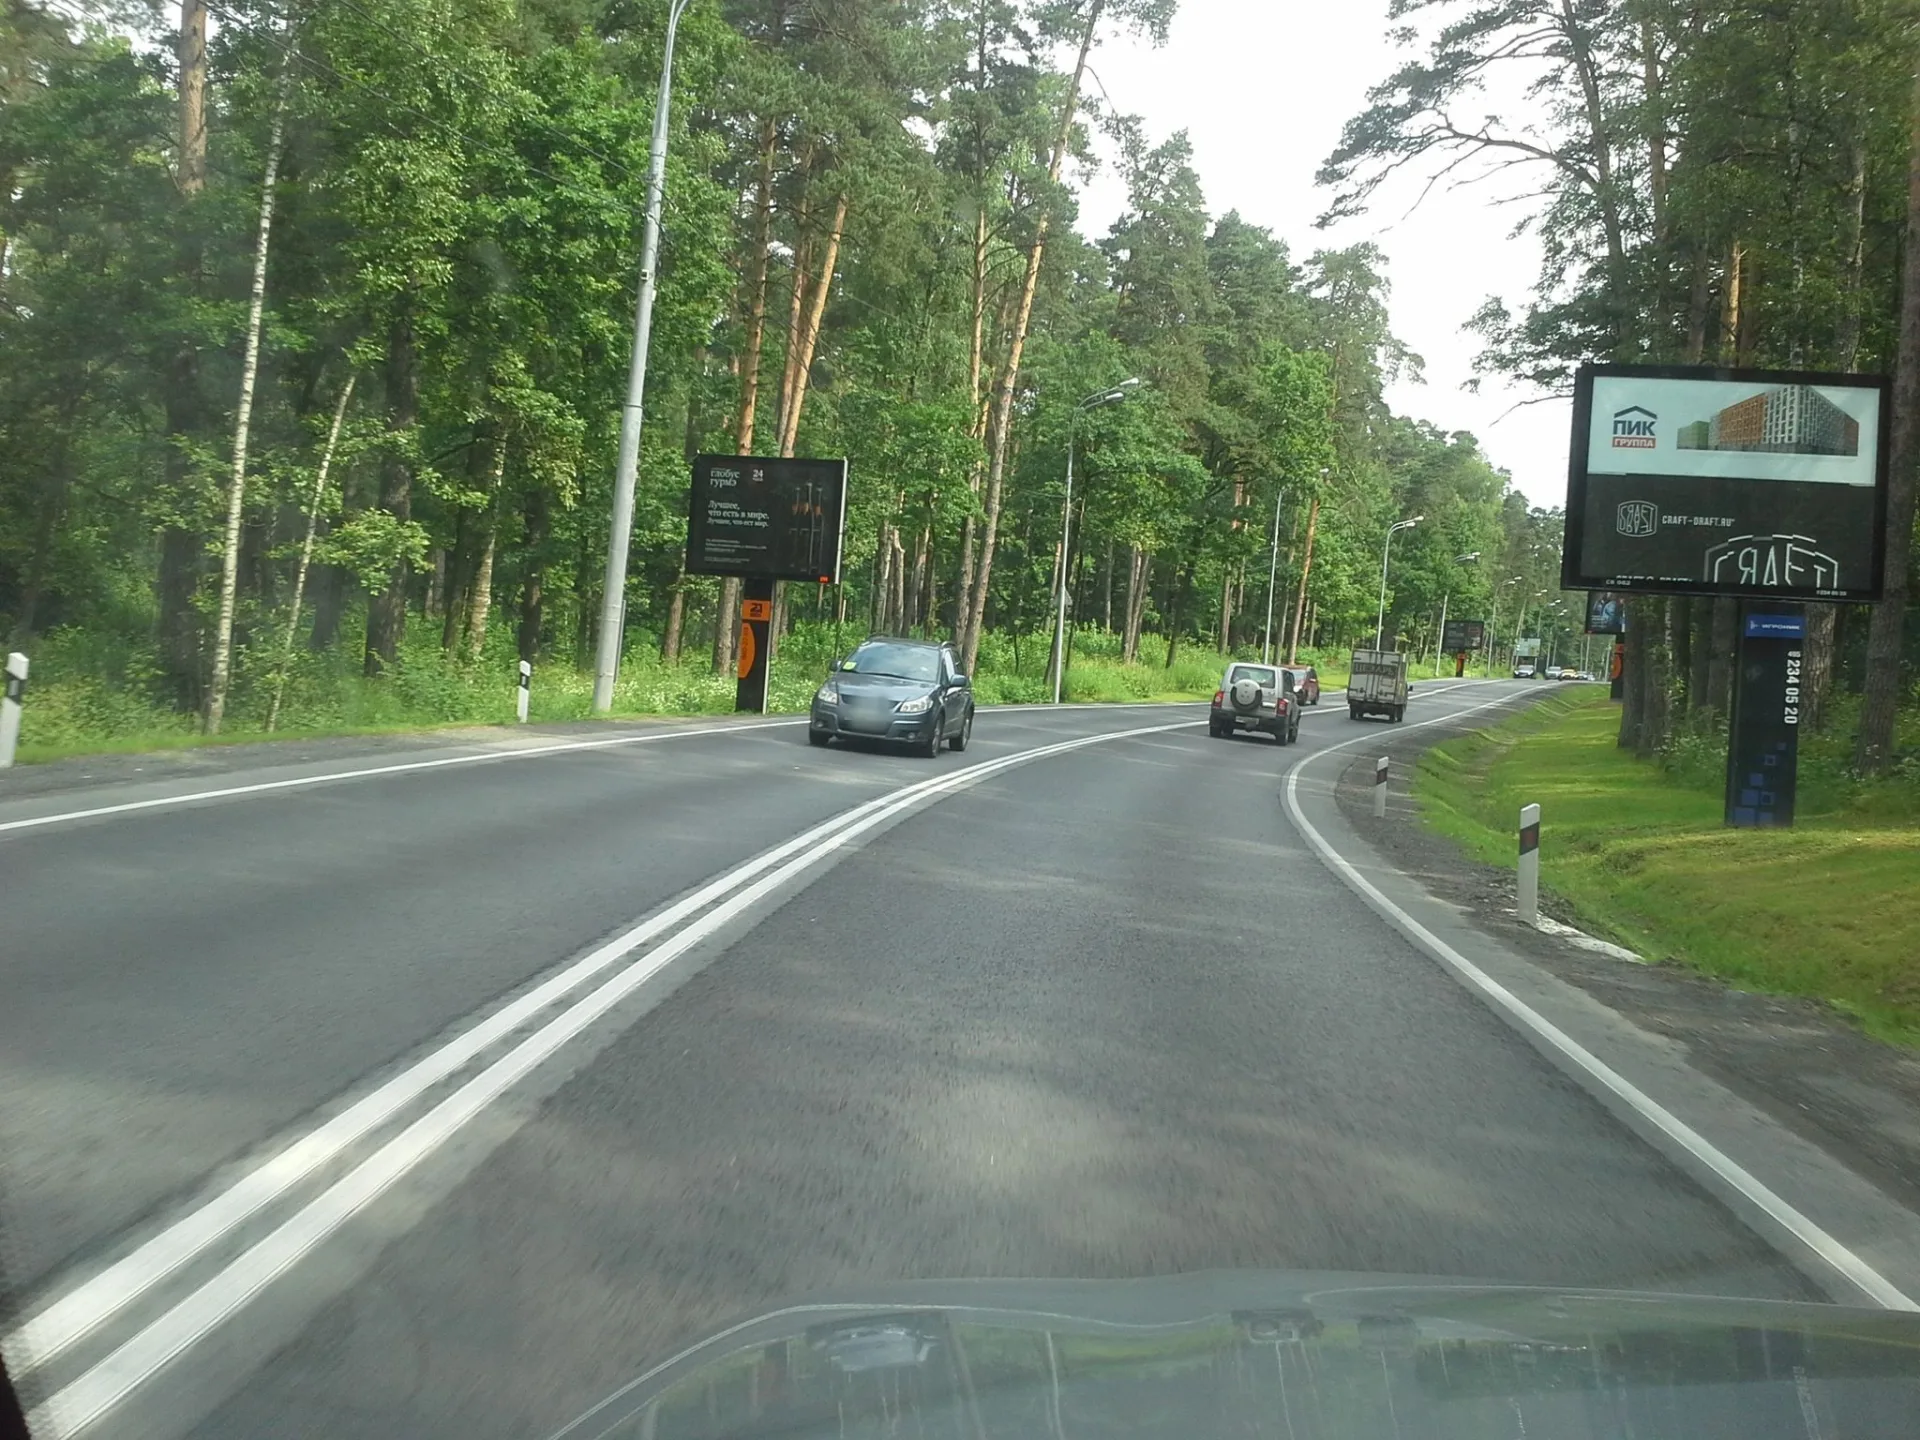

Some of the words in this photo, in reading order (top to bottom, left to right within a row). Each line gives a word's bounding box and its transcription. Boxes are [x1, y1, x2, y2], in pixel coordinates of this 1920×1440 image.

[1613, 420, 1656, 436] ПИК
[1614, 438, 1654, 447] ГРУППА
[710, 468, 740, 479] глобус
[752, 469, 764, 477] 24
[1786, 659, 1801, 684] 234
[1785, 687, 1799, 704] 05
[1784, 706, 1799, 724] 20
